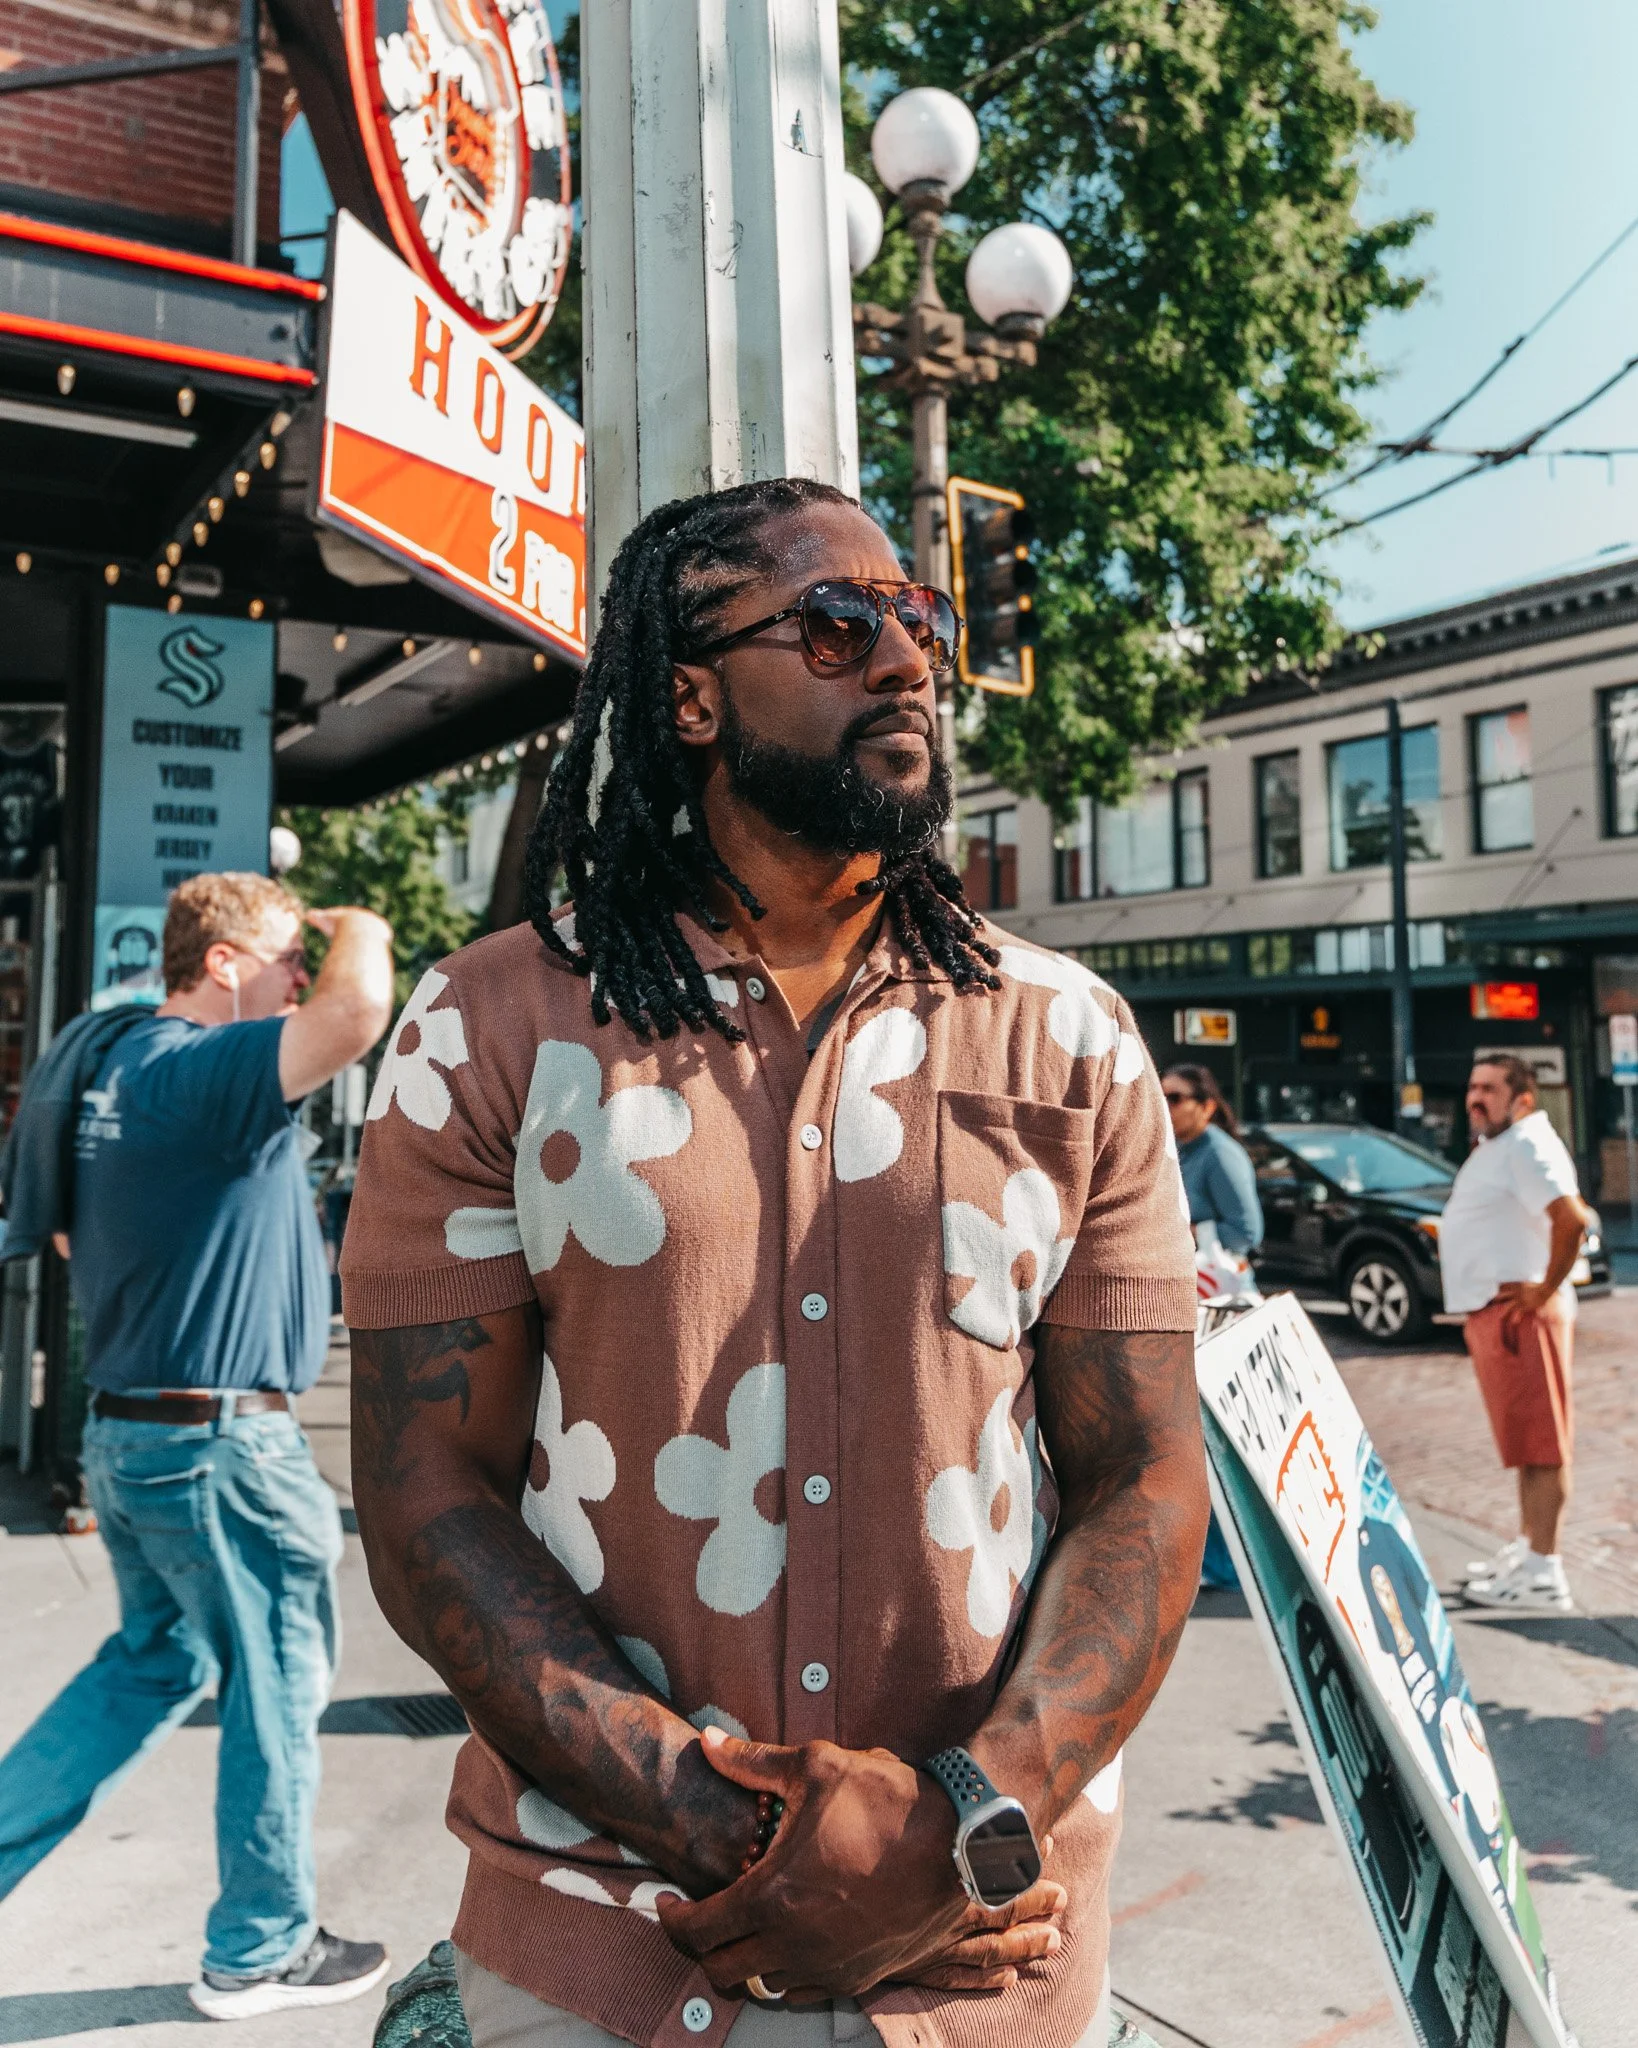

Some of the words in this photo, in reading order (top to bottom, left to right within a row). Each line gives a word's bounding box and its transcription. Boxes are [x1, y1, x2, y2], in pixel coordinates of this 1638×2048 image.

[488, 487, 518, 597] 2
[131, 718, 243, 751] CUSTOMIZE
[158, 762, 214, 791] YOUR
[152, 803, 219, 828] KRAKEN
[153, 838, 213, 861] JERSEY
